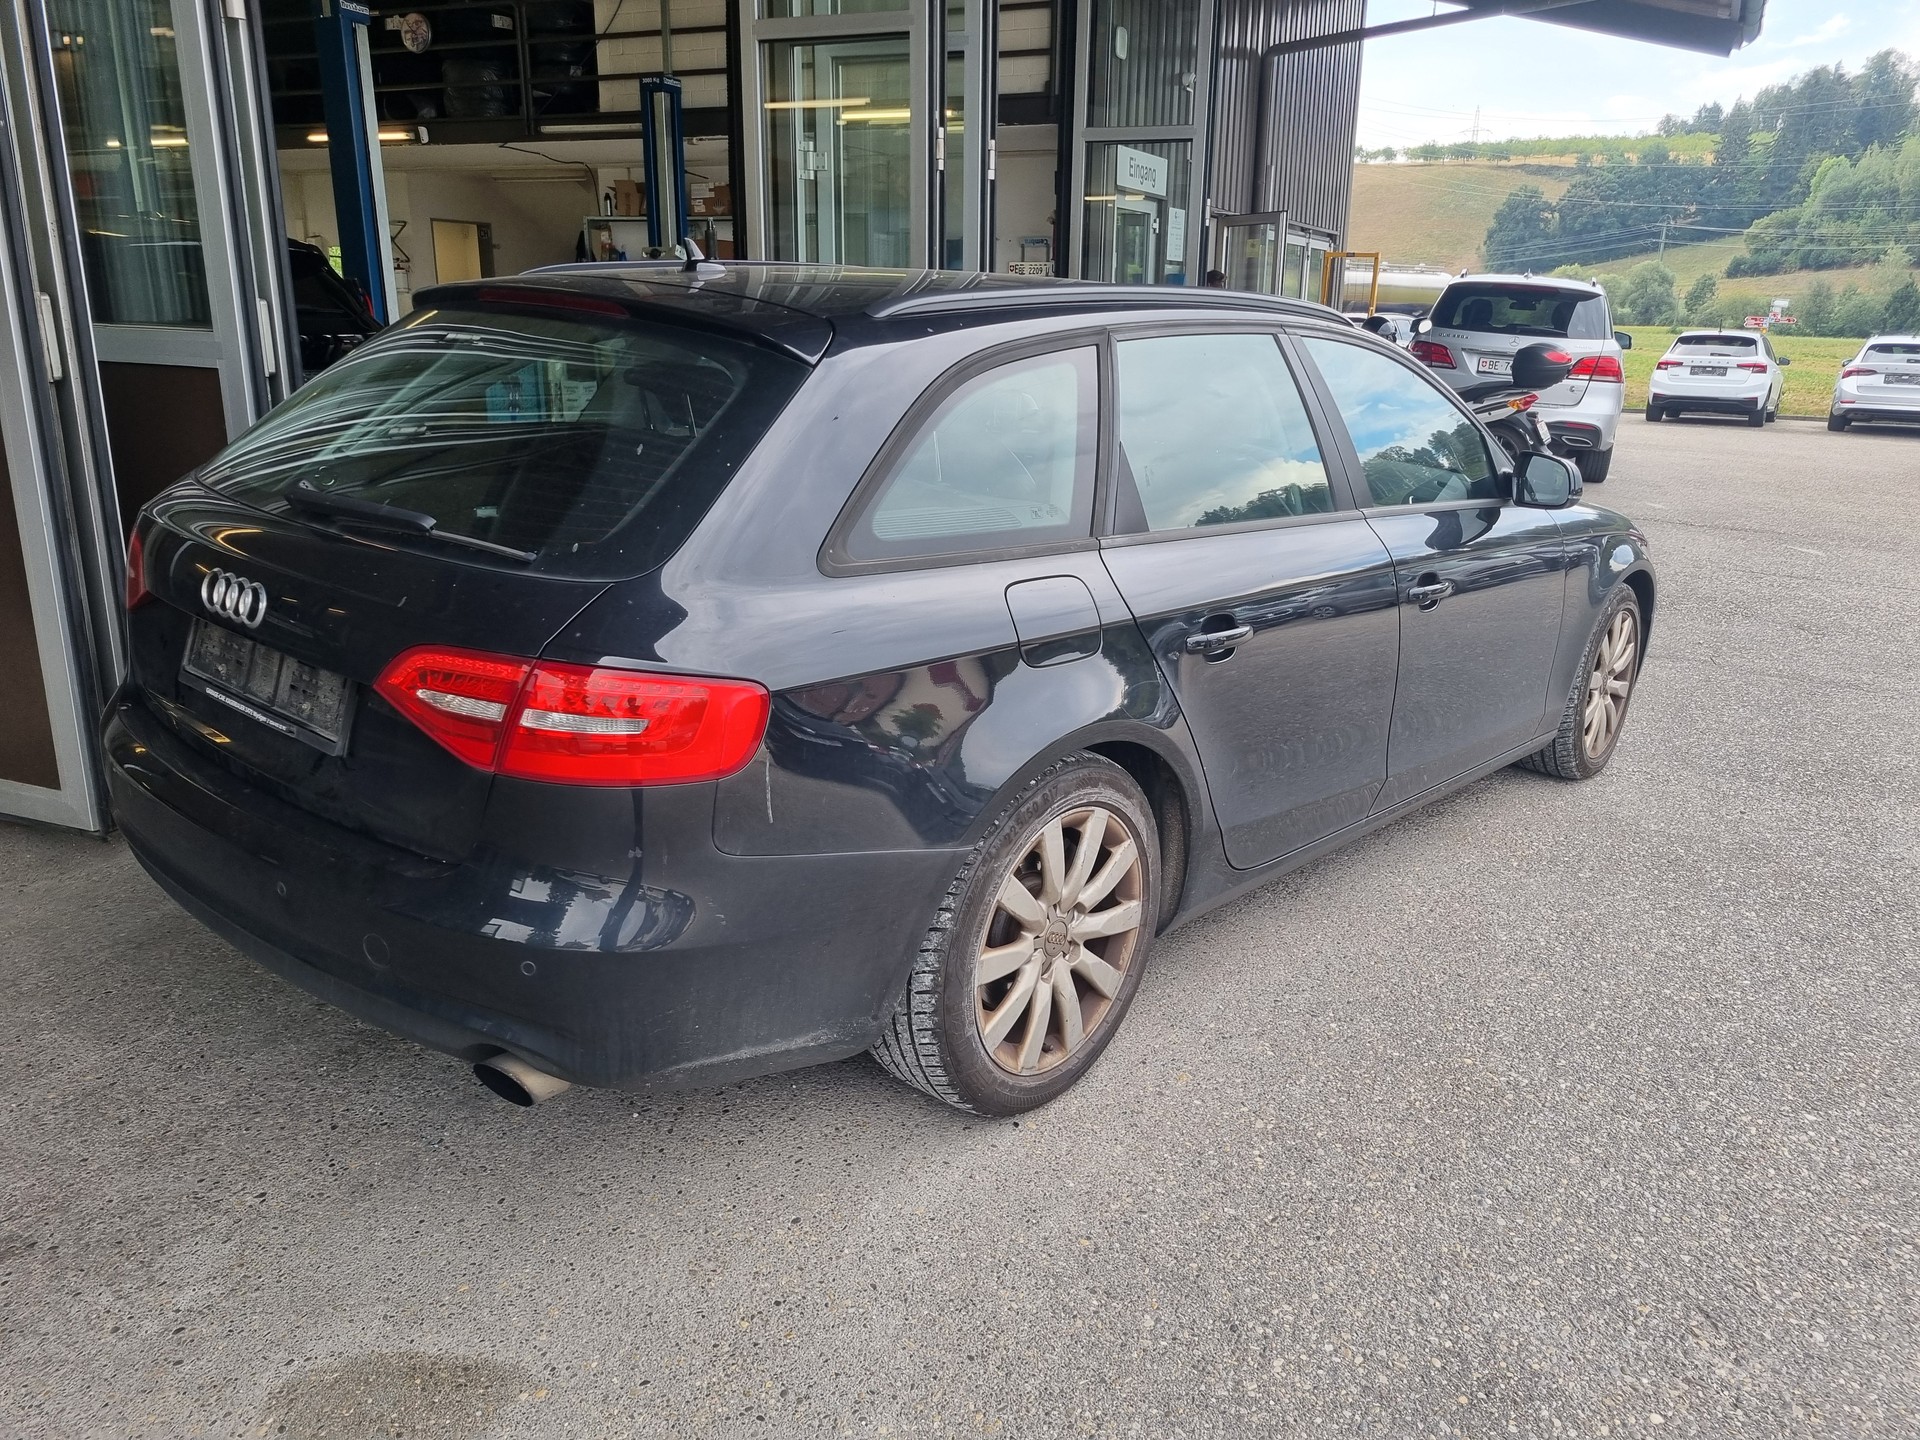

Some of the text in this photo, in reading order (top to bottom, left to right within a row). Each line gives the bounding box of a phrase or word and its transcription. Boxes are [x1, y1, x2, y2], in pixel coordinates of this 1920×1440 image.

[1128, 156, 1157, 188] Eingang
[1029, 266, 1043, 274] 2209
[1488, 360, 1500, 370] BE
